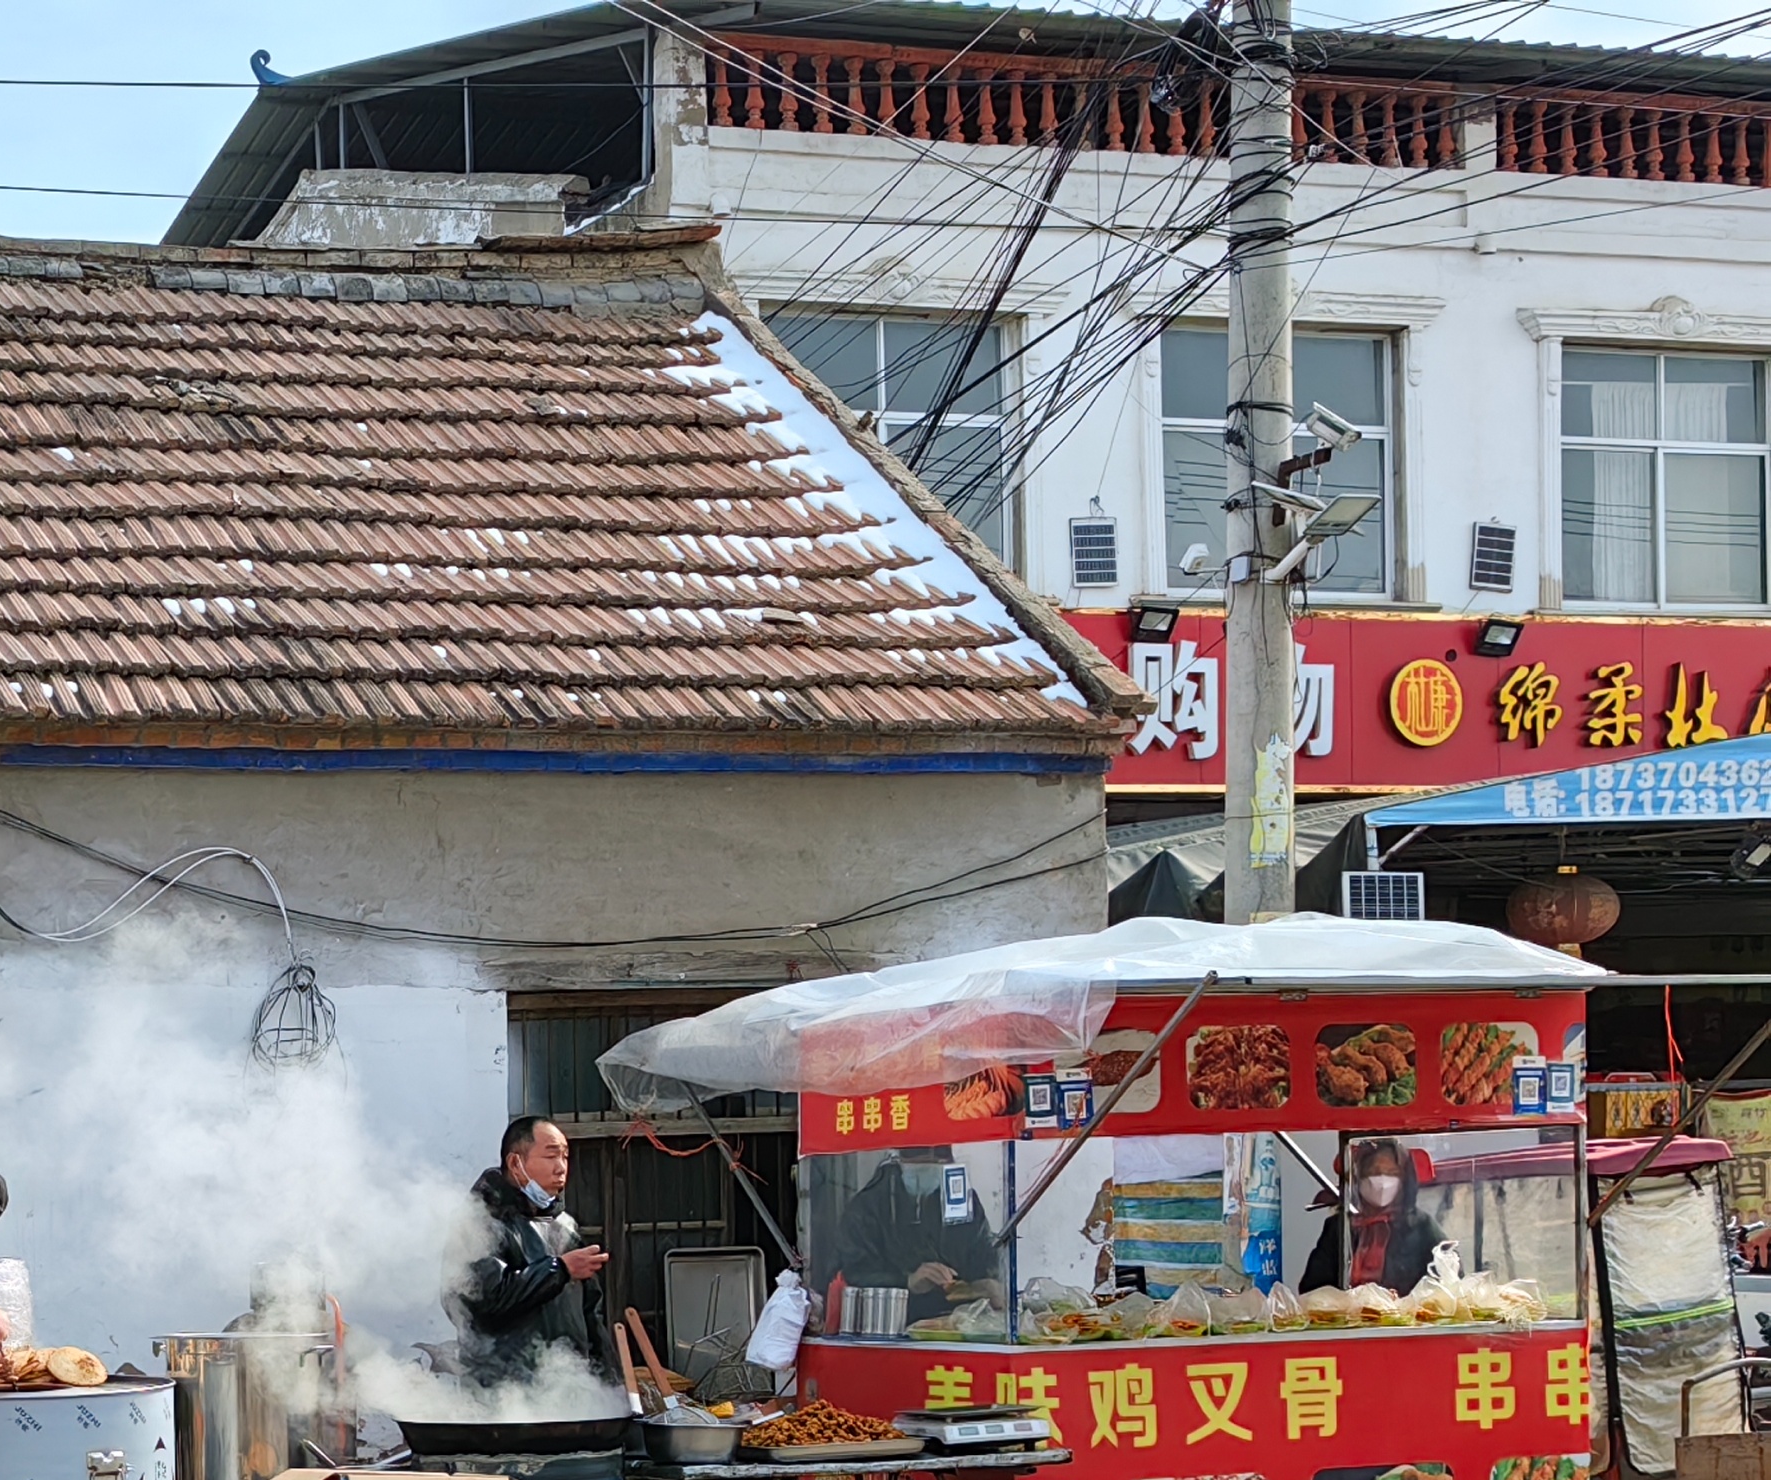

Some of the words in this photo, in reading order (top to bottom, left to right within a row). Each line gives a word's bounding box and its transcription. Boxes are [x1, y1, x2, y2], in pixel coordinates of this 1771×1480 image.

[1499, 660, 1771, 748] 绵柔杜
[835, 1093, 911, 1136] 串串香
